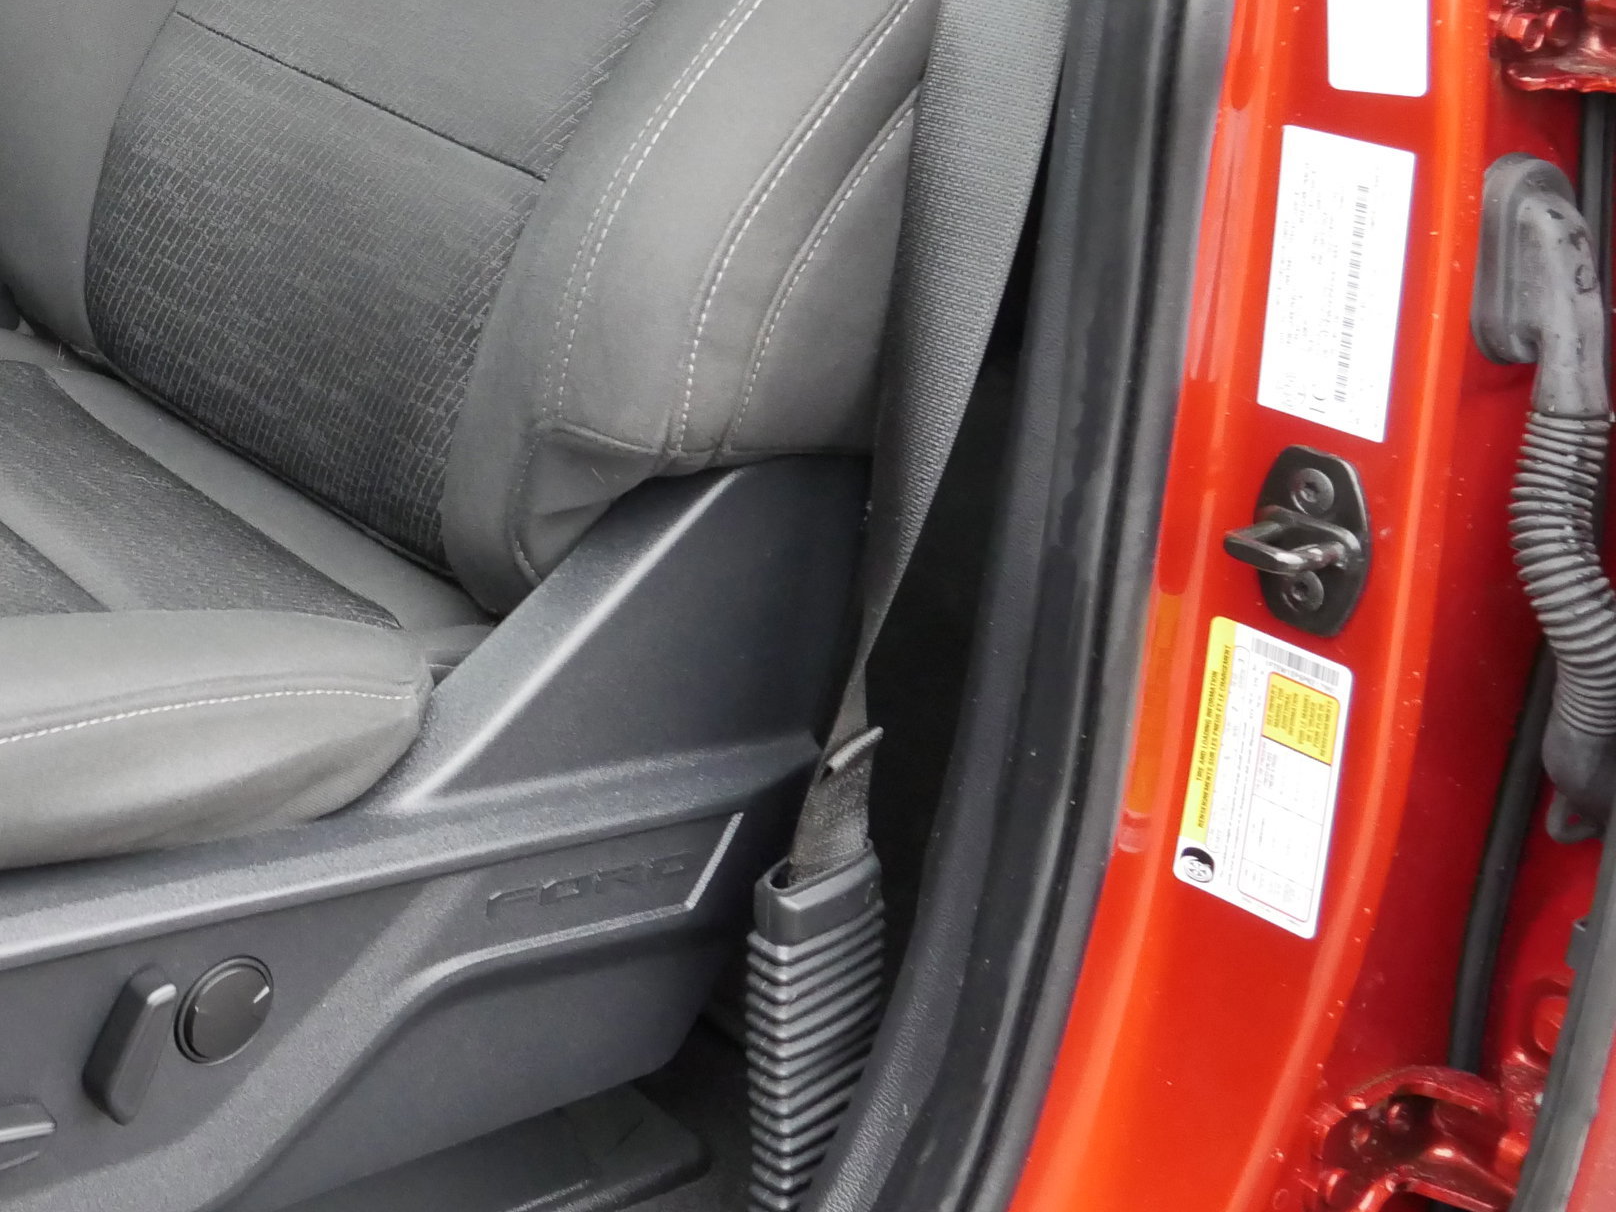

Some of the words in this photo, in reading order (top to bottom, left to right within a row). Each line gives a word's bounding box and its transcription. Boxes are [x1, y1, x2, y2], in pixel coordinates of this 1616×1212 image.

[1205, 669, 1219, 718] INFORMATION
[1200, 717, 1212, 749] LOADING
[1197, 748, 1207, 766] AND
[1195, 765, 1204, 782] TIRE
